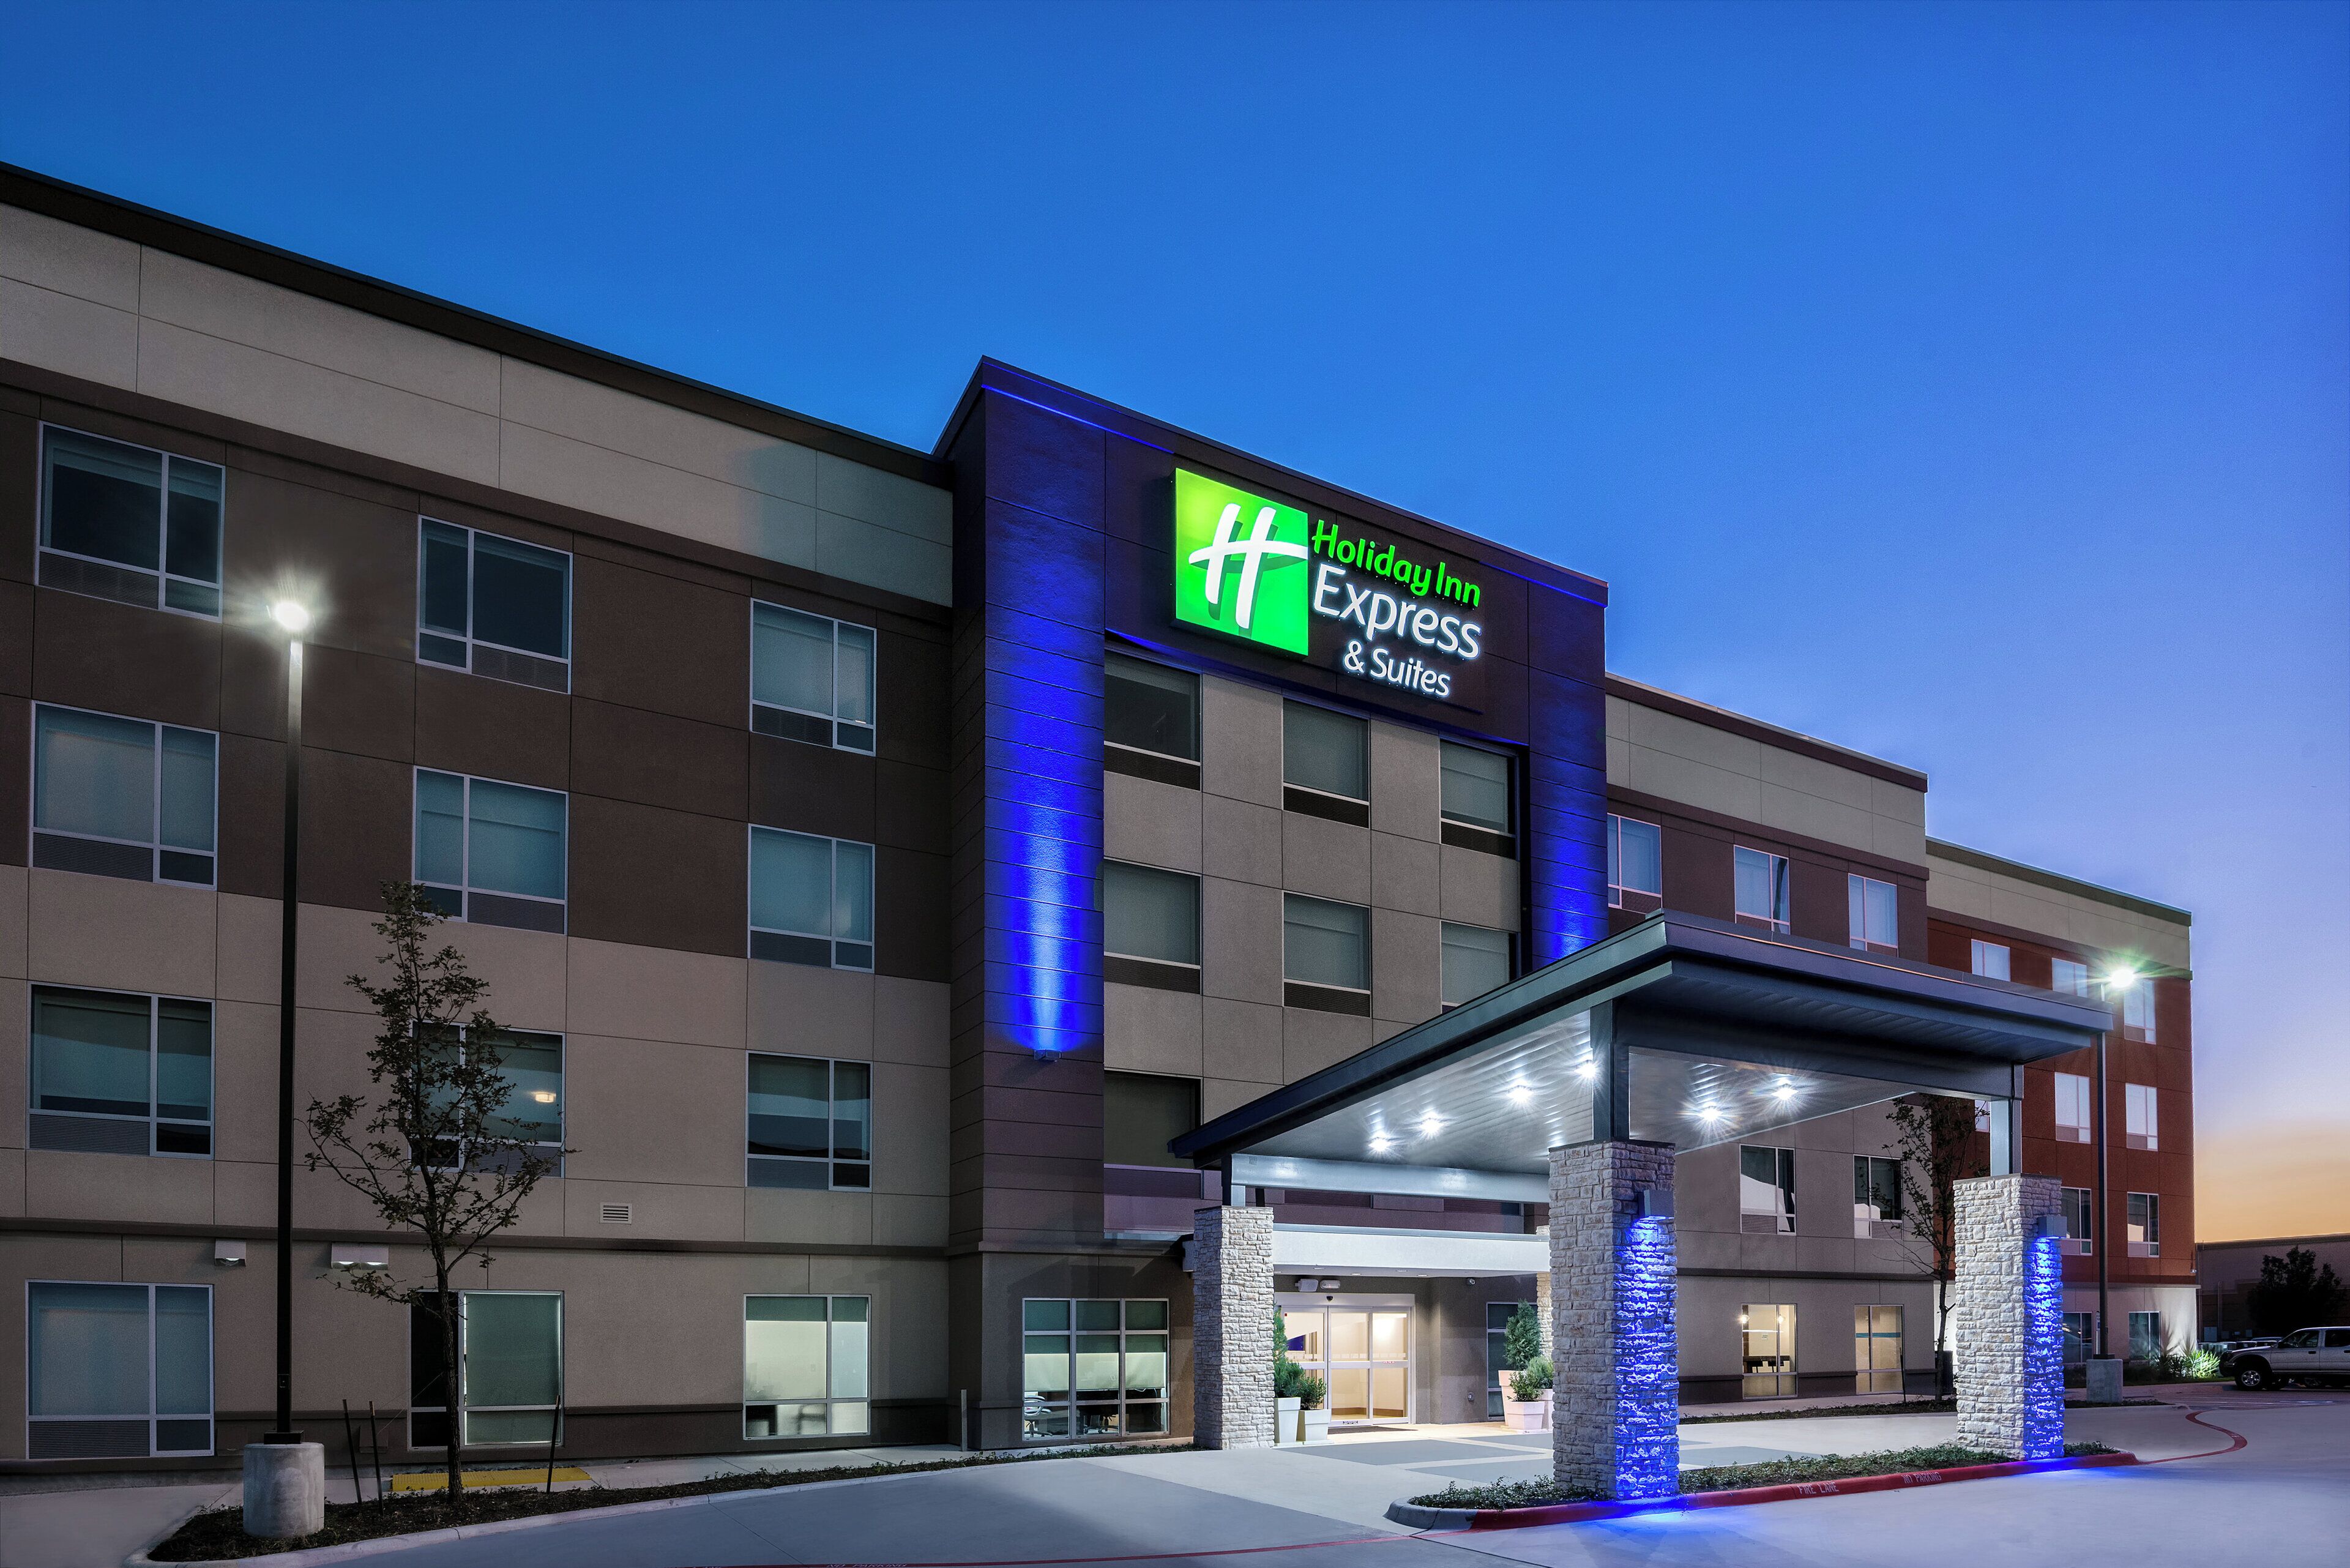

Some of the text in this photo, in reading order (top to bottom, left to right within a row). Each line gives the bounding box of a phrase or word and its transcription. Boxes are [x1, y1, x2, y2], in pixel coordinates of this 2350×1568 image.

[1311, 520, 1480, 607] Holiday Inn
[1314, 562, 1482, 659] Express
[1344, 640, 1450, 697] & Suites
[1797, 1482, 1839, 1495] FIRE LANE
[1901, 1472, 1941, 1484] NO PARKING
